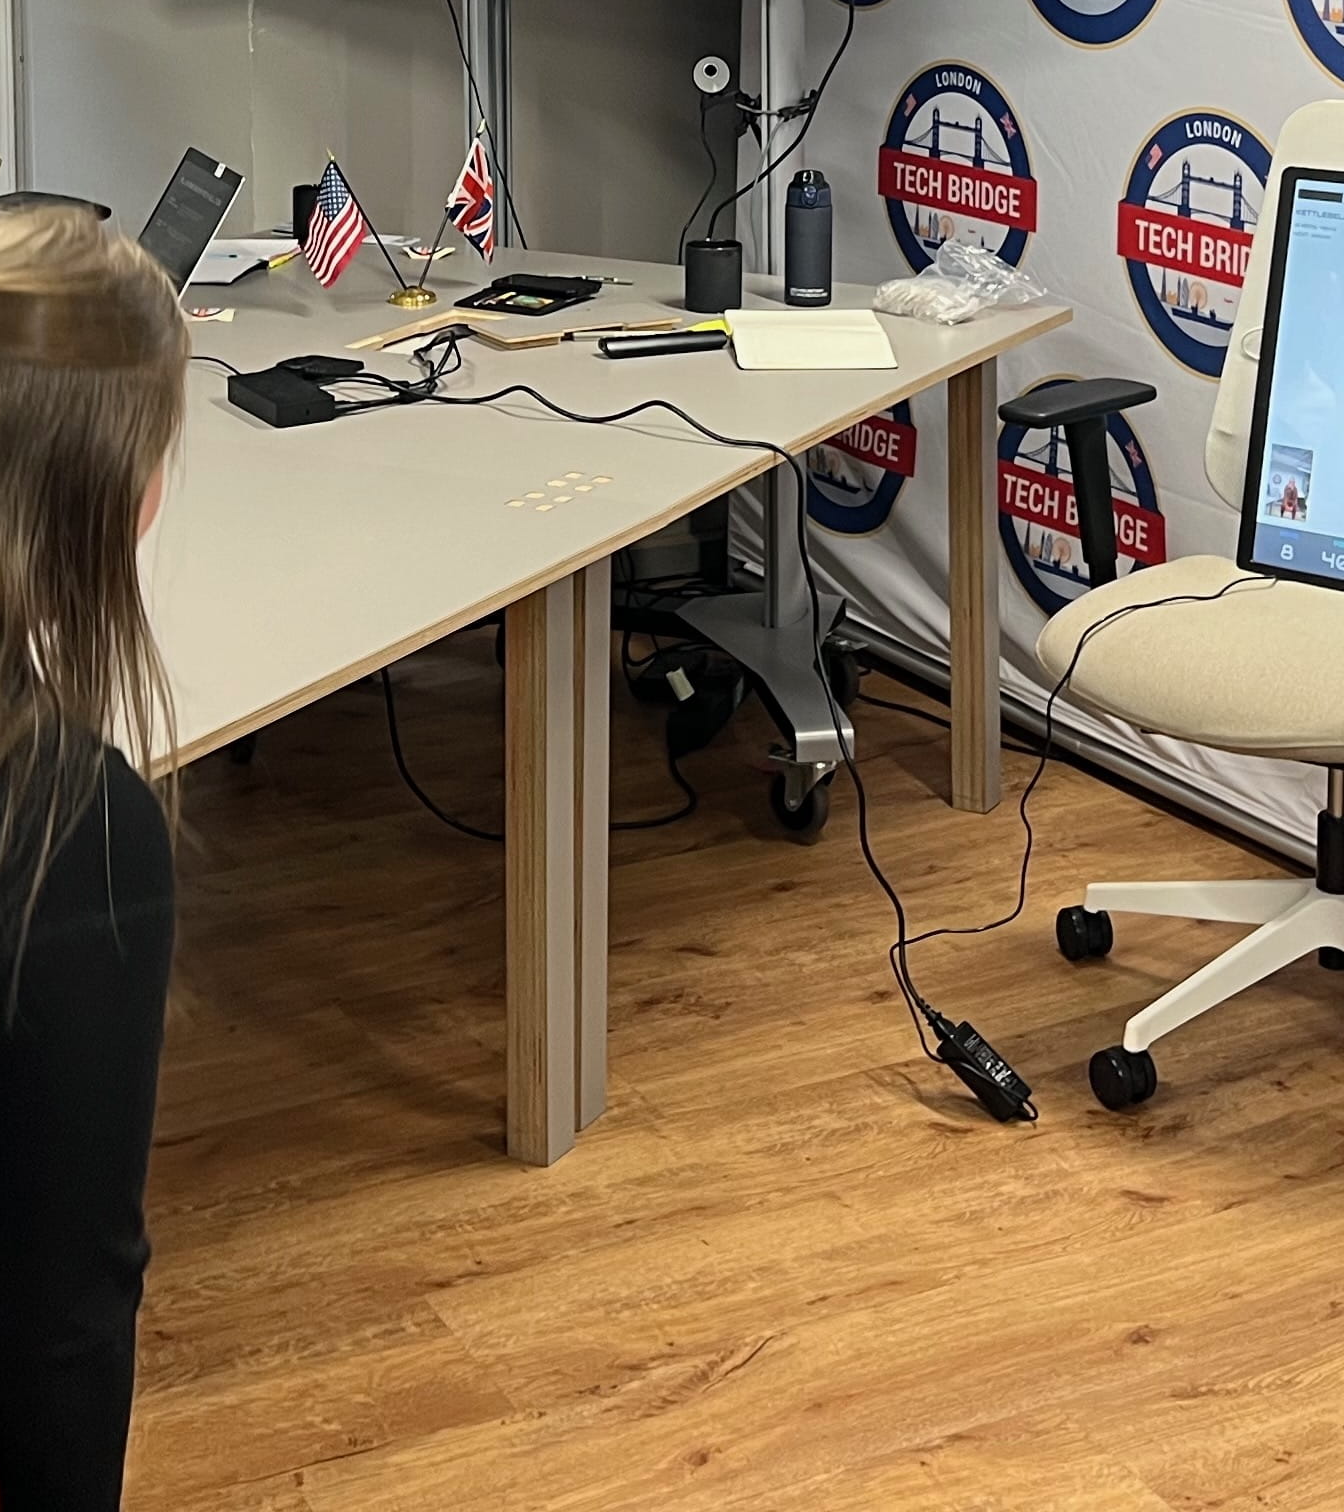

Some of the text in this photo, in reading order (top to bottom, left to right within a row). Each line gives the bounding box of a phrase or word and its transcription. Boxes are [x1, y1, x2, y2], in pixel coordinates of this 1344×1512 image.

[935, 71, 982, 96] LONDON
[1185, 120, 1242, 149] LONDON
[893, 161, 1021, 218] TECH BRIDGE
[1135, 219, 1253, 278] TECH BRID
[837, 423, 901, 462] RIDGE
[1003, 473, 1148, 552] TECH BGE
[1280, 544, 1294, 560] 8
